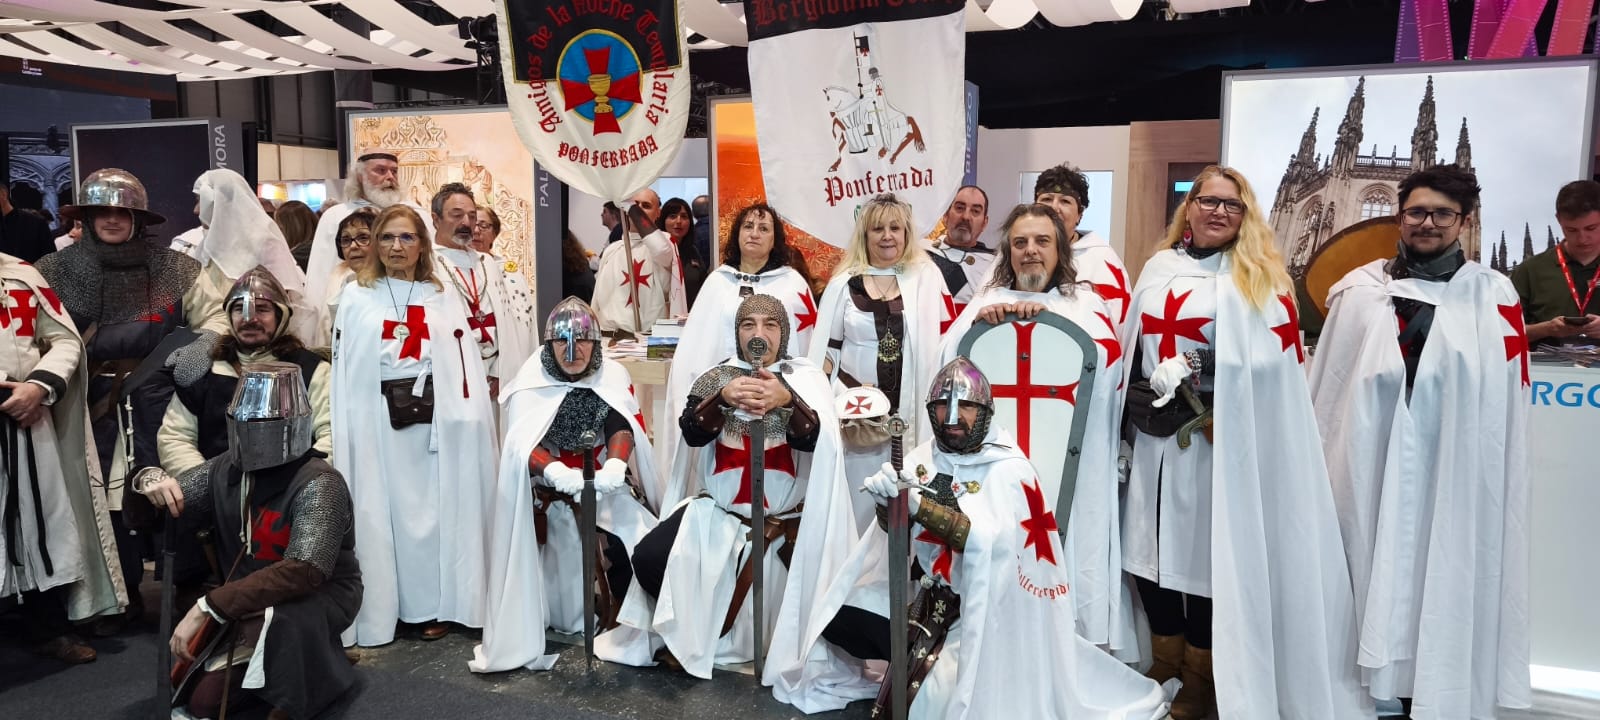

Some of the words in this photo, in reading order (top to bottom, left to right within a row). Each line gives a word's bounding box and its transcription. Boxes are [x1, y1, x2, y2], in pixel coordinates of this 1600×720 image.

[546, 5, 572, 26] la
[528, 25, 552, 49] de
[635, 10, 674, 126] Templaria
[528, 52, 563, 133] Amigos
[557, 134, 659, 169] PONFERRADA
[824, 166, 933, 207] Ponferrada
